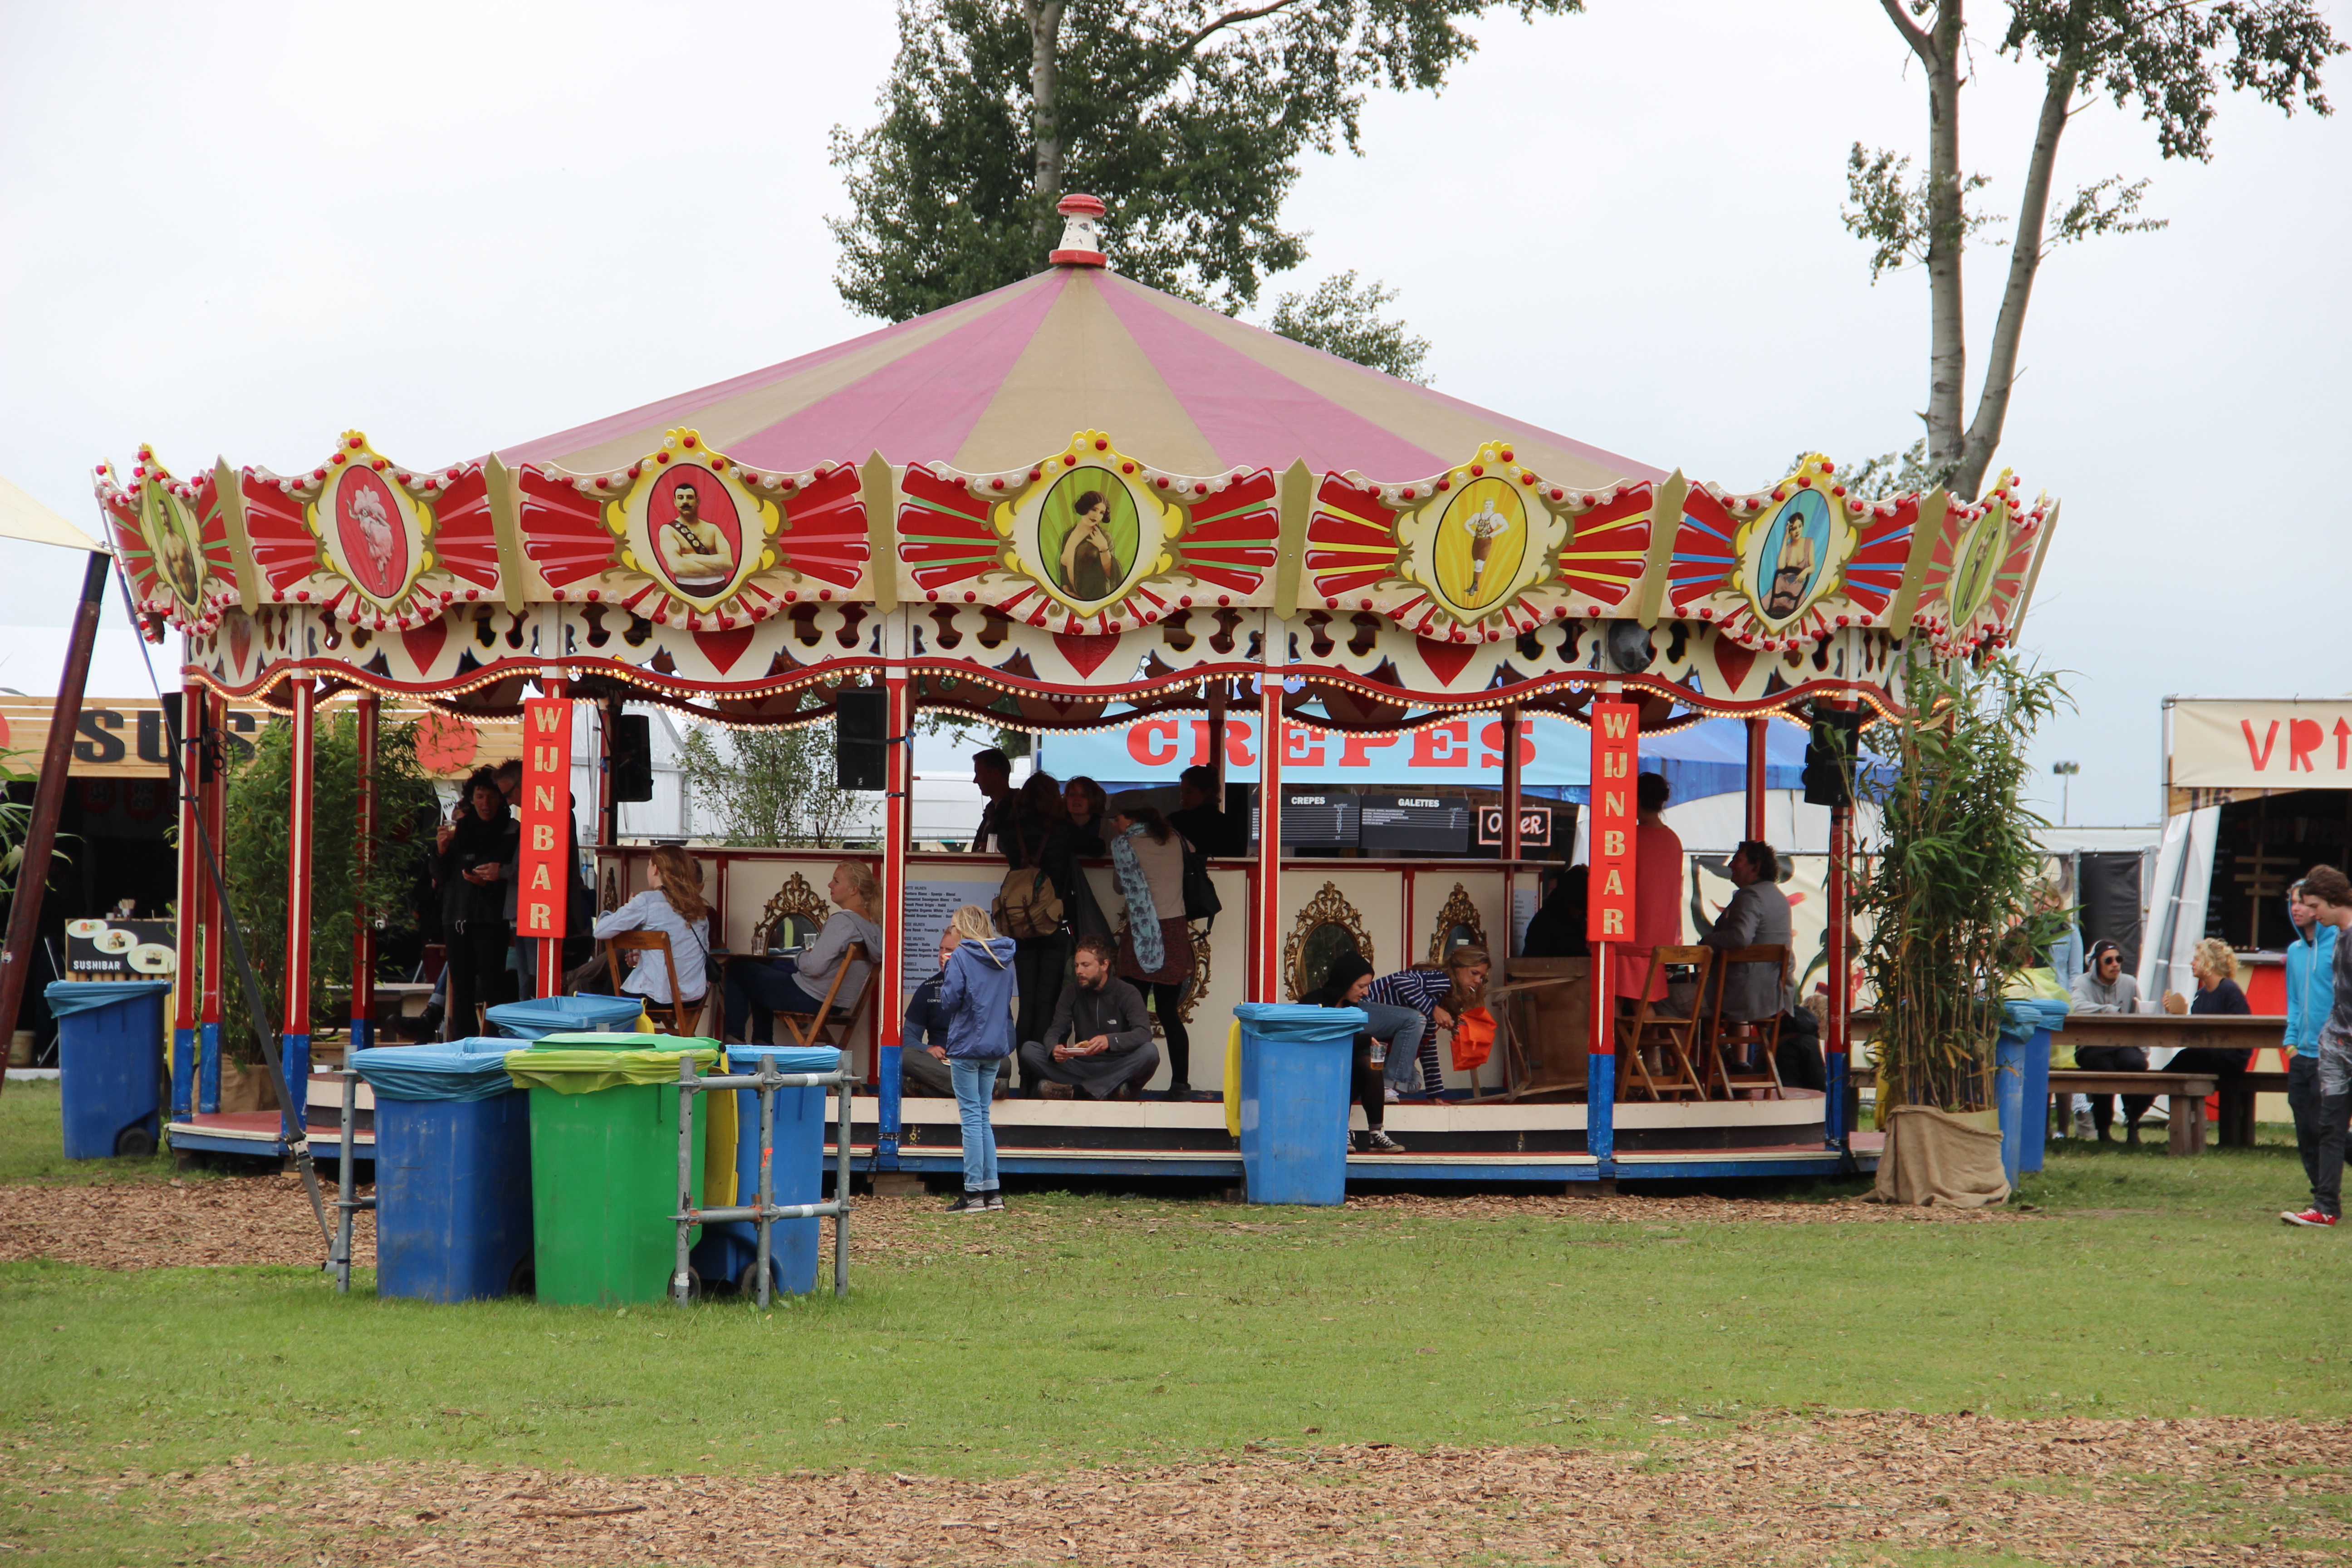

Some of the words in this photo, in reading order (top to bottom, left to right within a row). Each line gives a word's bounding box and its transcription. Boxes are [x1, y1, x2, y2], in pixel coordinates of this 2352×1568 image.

[1127, 719, 1537, 769] CREPES
[1291, 796, 1326, 805] CREPES
[1398, 798, 1440, 808] GALETTES
[529, 706, 563, 930] WIJNBAR
[1487, 812, 1545, 835] OeR
[1602, 712, 1631, 935] WIJNBAR
[73, 960, 120, 970] SUSHIBAR
